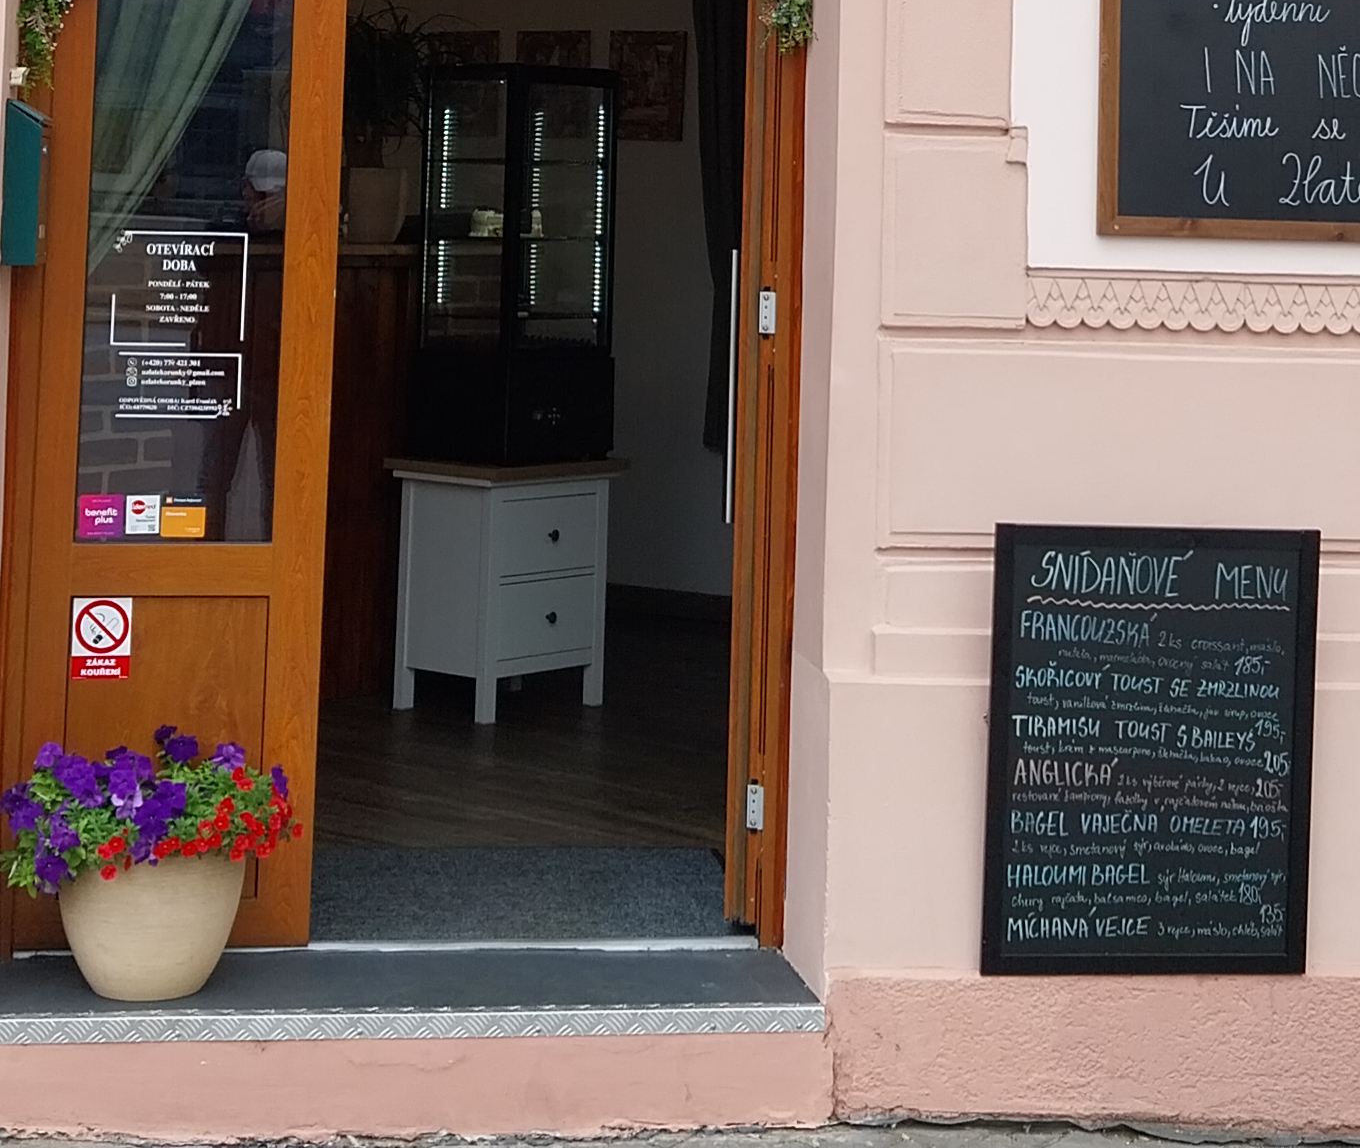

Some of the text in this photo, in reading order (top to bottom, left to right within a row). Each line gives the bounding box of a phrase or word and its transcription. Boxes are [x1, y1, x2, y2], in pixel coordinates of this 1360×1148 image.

[1203, 46, 1212, 93] I
[1236, 48, 1275, 95] NA
[1180, 103, 1280, 139] Těšíme
[1312, 119, 1346, 140] se
[1194, 154, 1230, 206] U
[146, 241, 215, 257] OTEVÍRACÍ
[162, 259, 197, 272] DOBA
[147, 279, 210, 288] PONDĚLÍ PÁTEK
[159, 314, 196, 323] ZAVŘENO
[180, 304, 210, 313] NEDĚLE
[85, 507, 118, 517] benefit
[94, 516, 113, 526] plus
[1031, 550, 1289, 601] SNÍDAŇOVÉ MENU
[1020, 610, 1157, 648] FRANCOUZSKÁ
[80, 667, 121, 677] KOUŘENÍ
[85, 657, 117, 667] ZÁKAZ
[1015, 660, 1280, 699] SKOŘICOVÝ TOUST SE ZMRZLINOU
[1012, 715, 1100, 738] TIRAMISU
[1115, 720, 1172, 743] TOUST
[1177, 724, 1187, 748] S
[1014, 757, 1118, 786] ANGLICKÁ
[1011, 810, 1069, 836] BAGEL
[1170, 815, 1245, 836] OMELETA
[1007, 863, 1150, 888] HALOUMI BAGEL
[1007, 907, 1151, 942] MÍCHANÁ VEJCE
